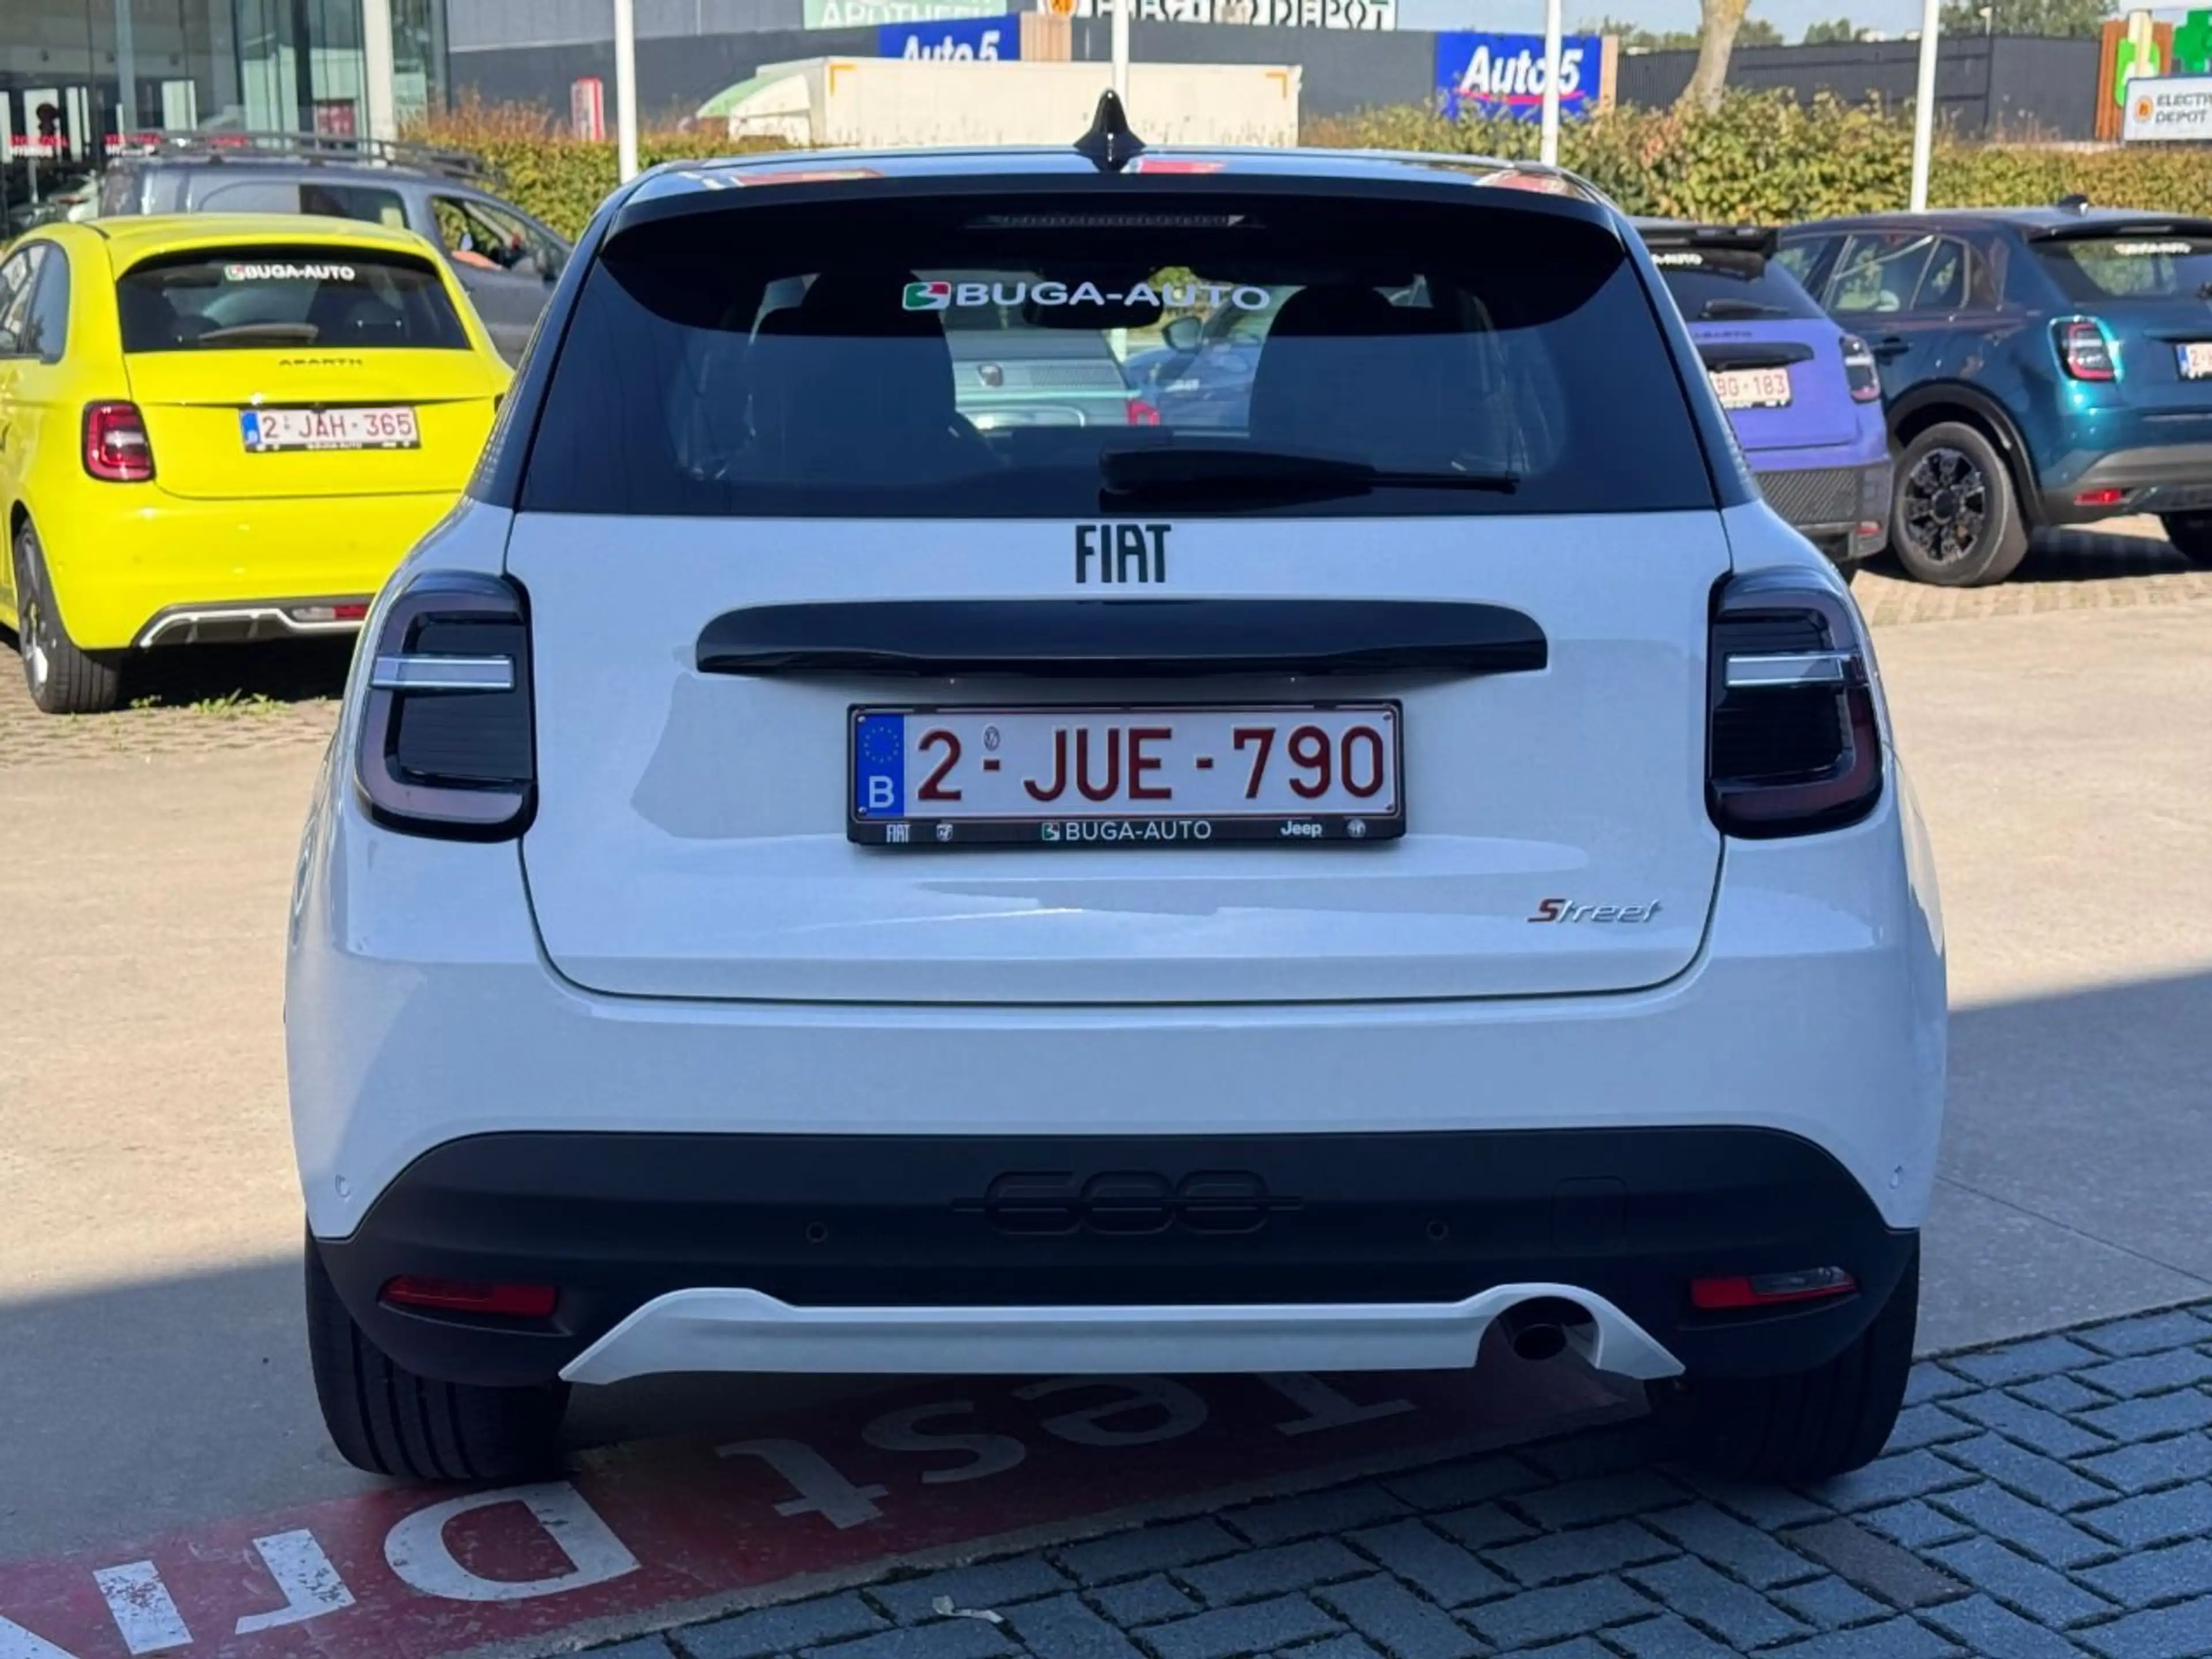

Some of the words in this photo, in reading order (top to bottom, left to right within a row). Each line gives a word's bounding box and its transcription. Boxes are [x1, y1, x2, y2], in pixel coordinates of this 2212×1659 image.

[244, 264, 355, 281] BUGA-AUTO
[956, 282, 1270, 310] BUGA-AUTO
[1075, 524, 1172, 583] FIAT
[869, 775, 894, 808] B
[885, 824, 911, 843] FIAT
[1065, 820, 1212, 841] BUGA-AUTO
[1279, 821, 1323, 838] Jeep
[1527, 898, 1662, 924] Street
[714, 1372, 1416, 1530] Test
[0, 1482, 641, 1659] Dri
